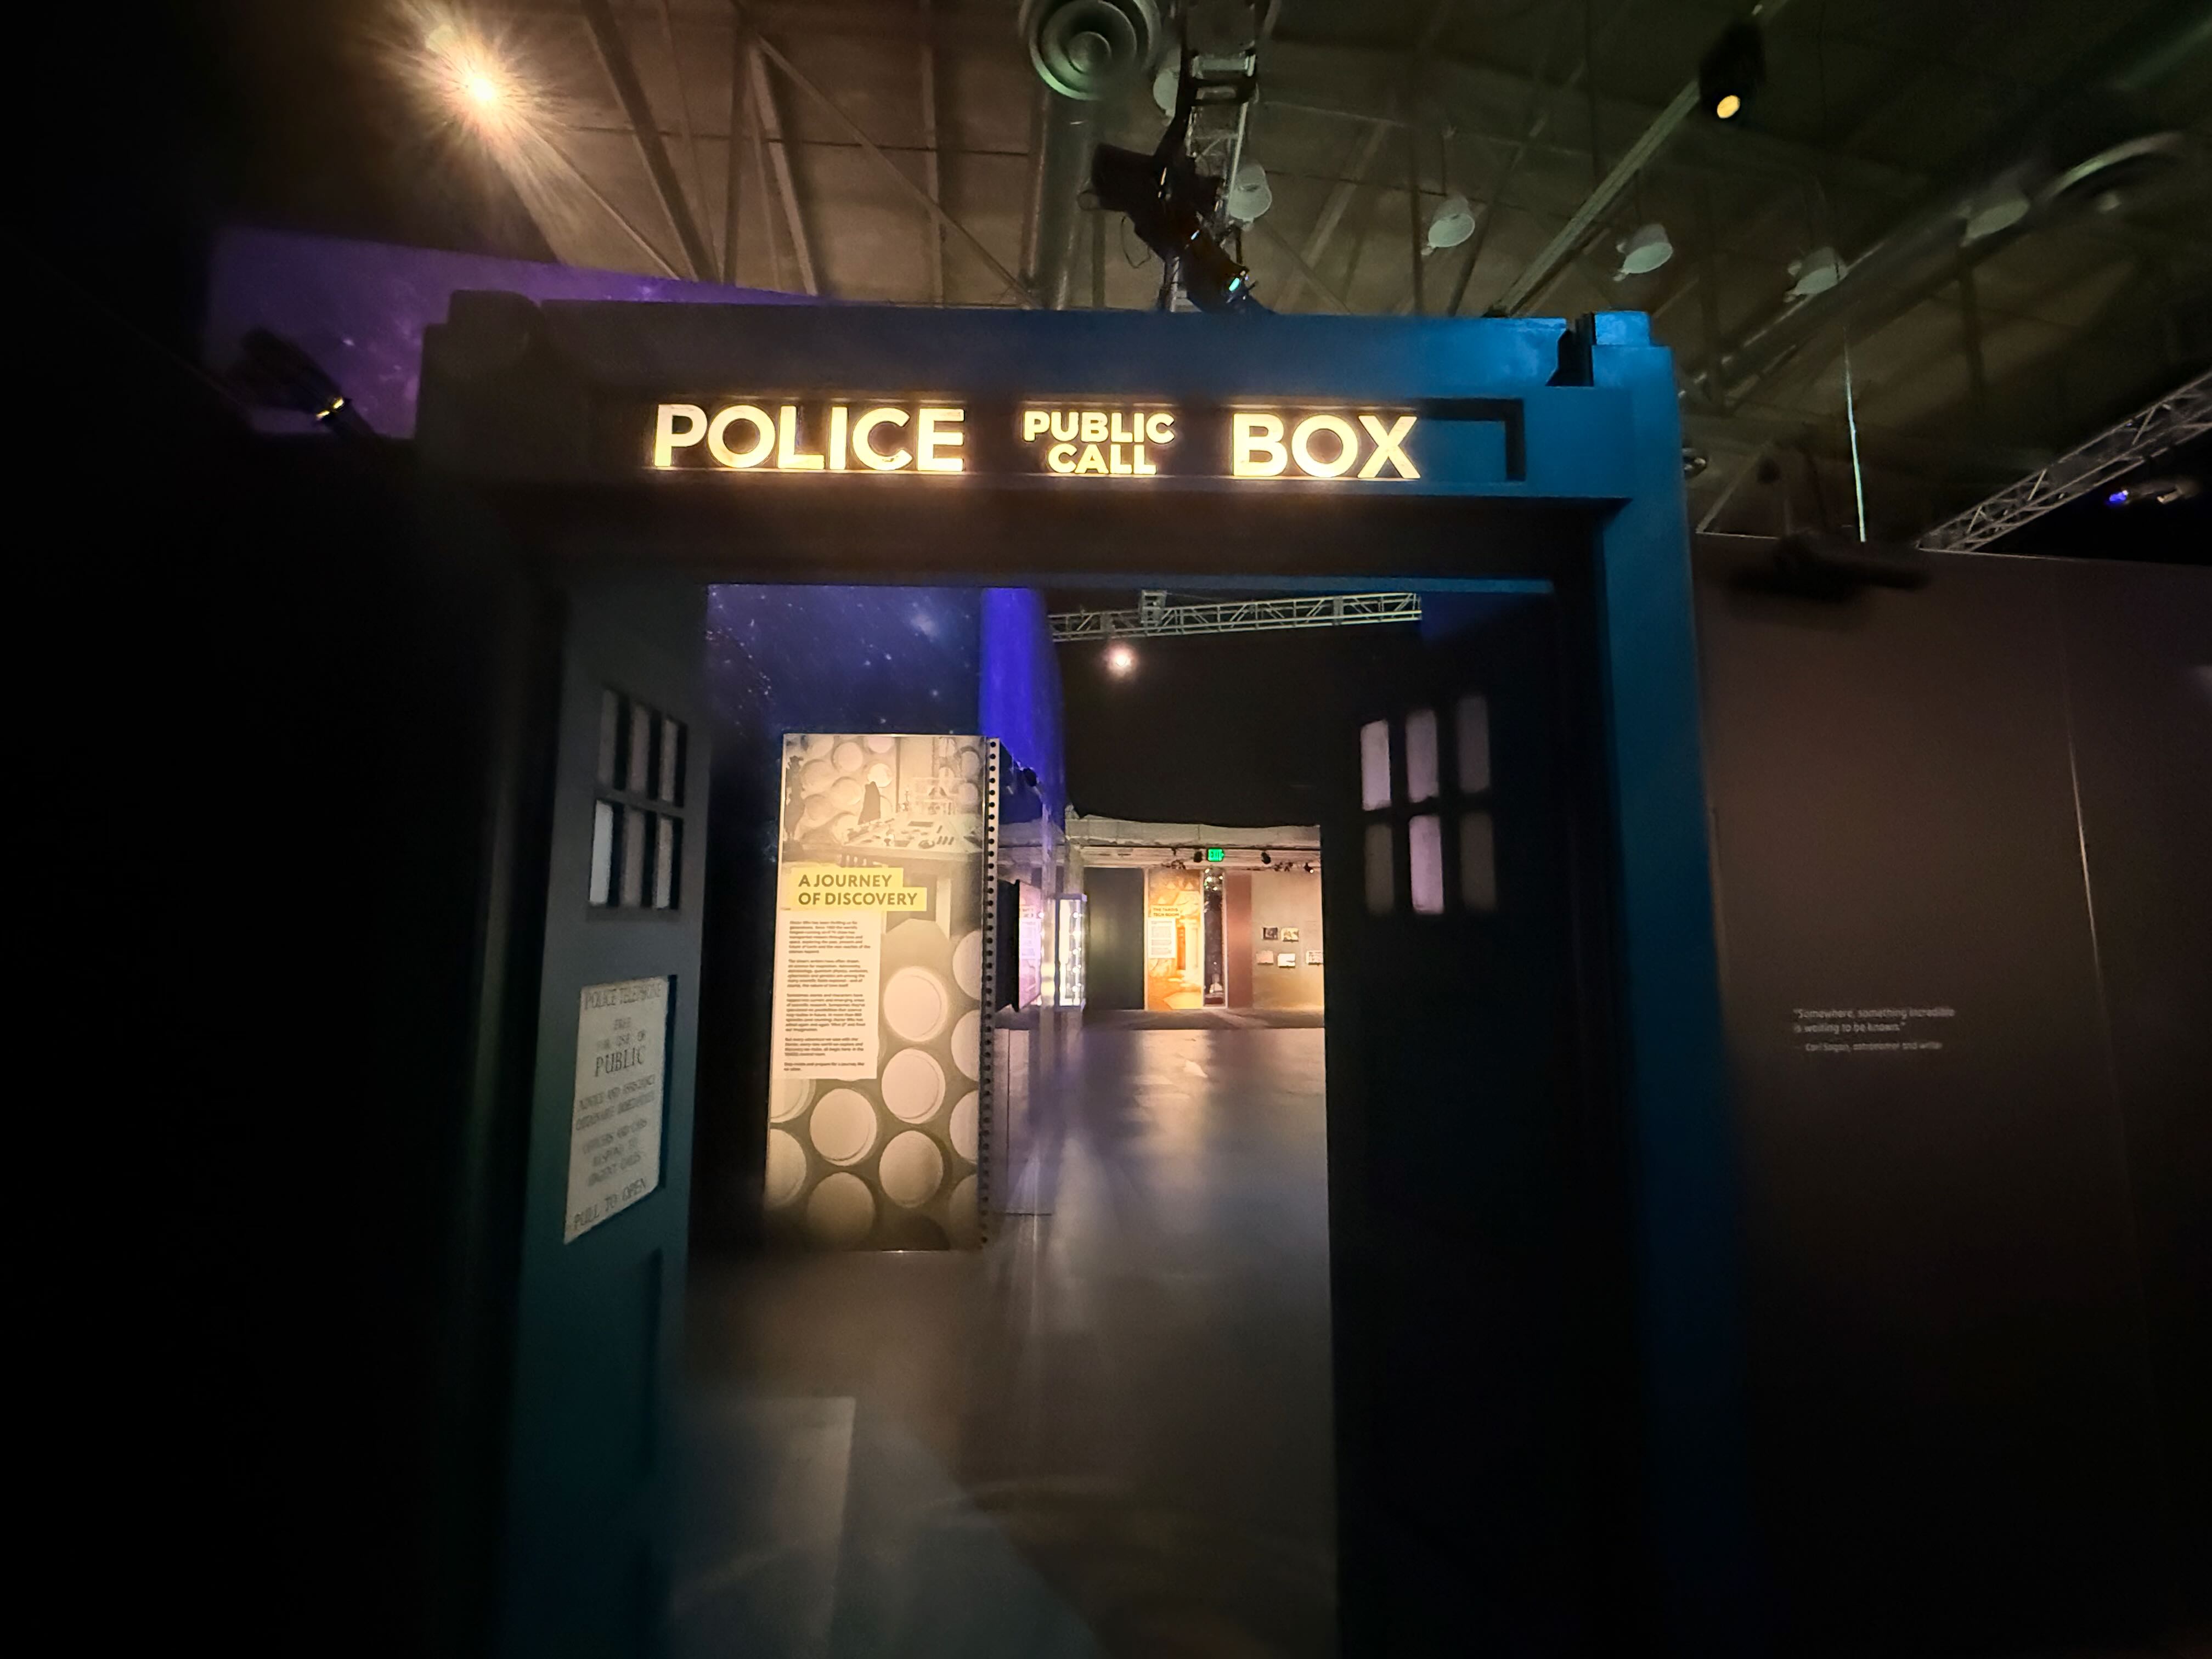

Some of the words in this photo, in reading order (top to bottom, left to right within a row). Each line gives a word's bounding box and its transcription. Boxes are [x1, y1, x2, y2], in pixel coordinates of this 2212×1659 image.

[653, 404, 965, 471] POLICE
[1024, 411, 1175, 444] PUBLIC
[1047, 443, 1158, 475] CALL
[1233, 413, 1421, 479] BOX
[798, 874, 810, 887] A
[814, 874, 892, 887] JOURNEY
[798, 893, 821, 905] OF
[825, 893, 918, 905] DISCOVERY
[595, 1045, 647, 1077] PUBLIC
